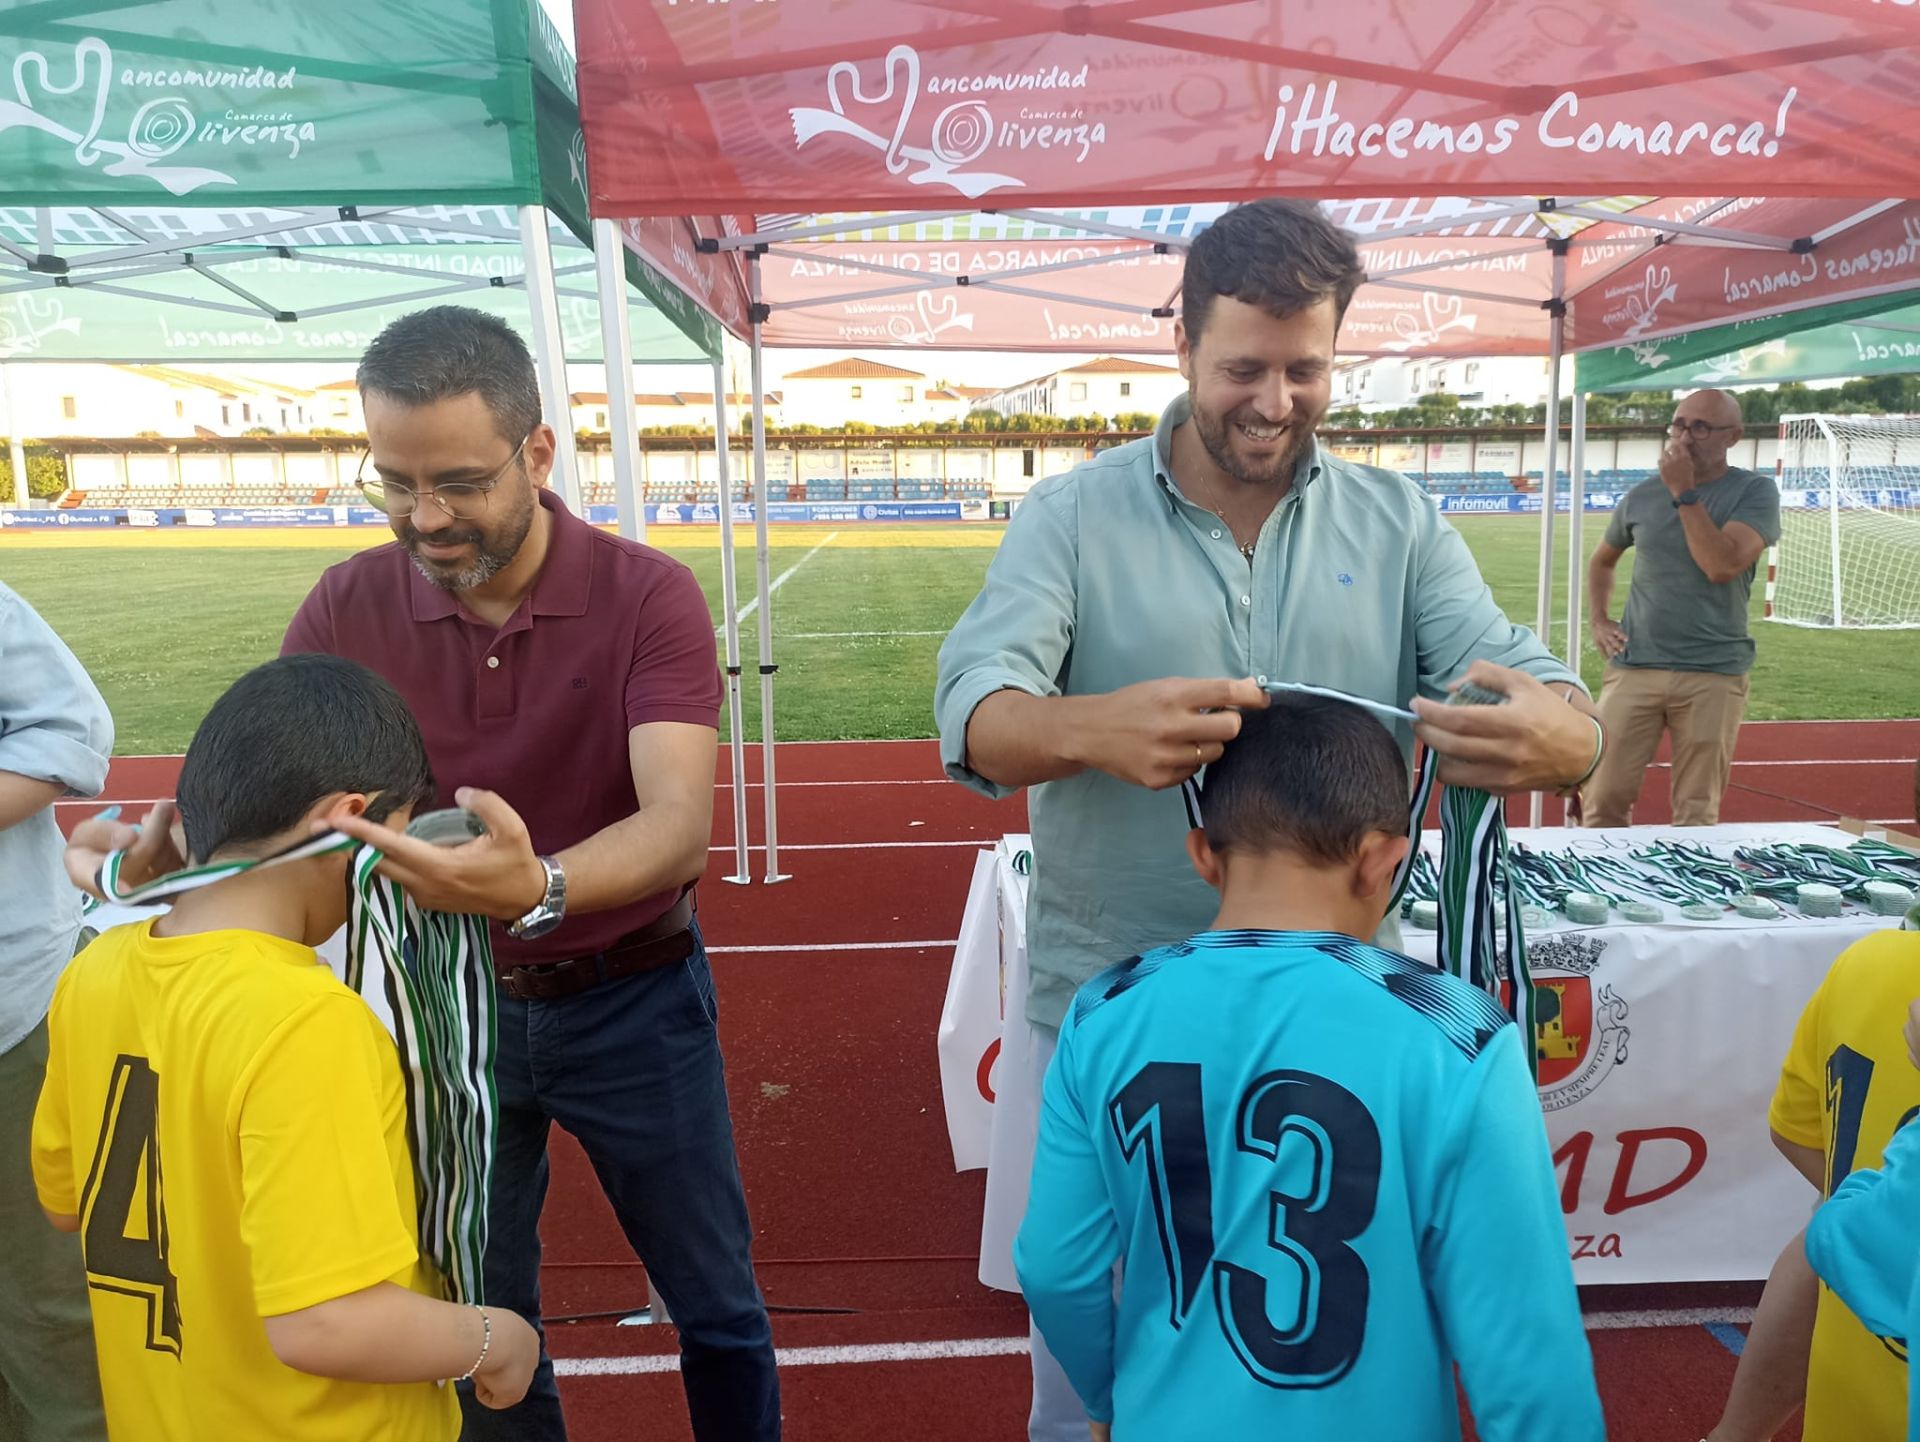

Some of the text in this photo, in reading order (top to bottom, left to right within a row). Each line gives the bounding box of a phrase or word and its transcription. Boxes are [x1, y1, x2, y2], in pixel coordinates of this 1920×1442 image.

[224, 110, 293, 122] Comarca de
[1019, 107, 1083, 119] Comarca de
[1264, 80, 1797, 161] ¡Hacemos Comarca!
[79, 1053, 182, 1363] 4
[1108, 1061, 1382, 1390] 13
